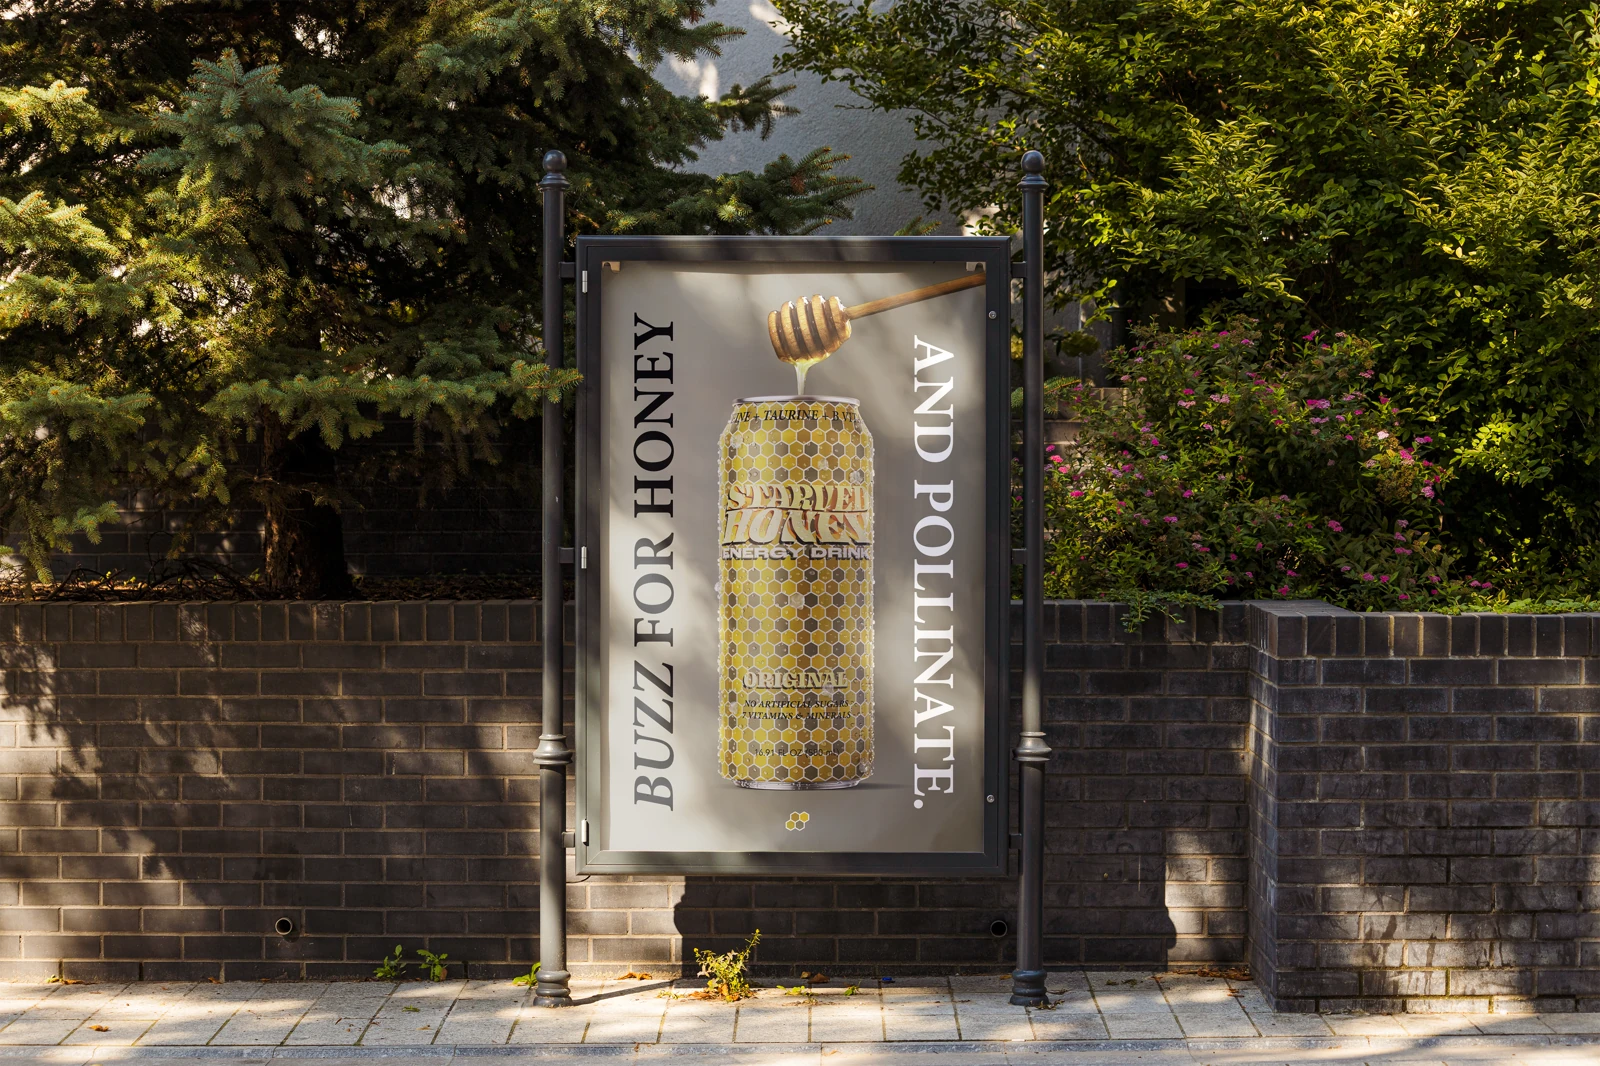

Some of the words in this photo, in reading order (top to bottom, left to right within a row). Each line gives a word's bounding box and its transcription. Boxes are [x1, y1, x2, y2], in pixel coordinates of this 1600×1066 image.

[913, 334, 955, 463] AND
[633, 311, 675, 519] HONEY
[763, 409, 819, 421] TAURINE
[832, 410, 840, 421] B
[726, 483, 869, 512] STARVED
[722, 508, 872, 545] HONEY
[722, 547, 801, 561] ENERGY
[809, 547, 871, 561] DRINK
[633, 532, 675, 648] FOR
[913, 479, 955, 809] POLLINATE.
[743, 671, 848, 689] ORIGINAL
[742, 711, 747, 719] 7
[748, 711, 794, 720] VITAMINS
[795, 712, 802, 720] &
[806, 711, 851, 720] MINERALS
[744, 699, 757, 708] NO
[759, 699, 812, 709] ARTIFICIAL
[815, 699, 849, 708] SUGARS
[633, 659, 675, 812] BUZZ
[755, 748, 774, 757] 16.91
[778, 748, 786, 757] FL
[790, 748, 803, 757] OZ
